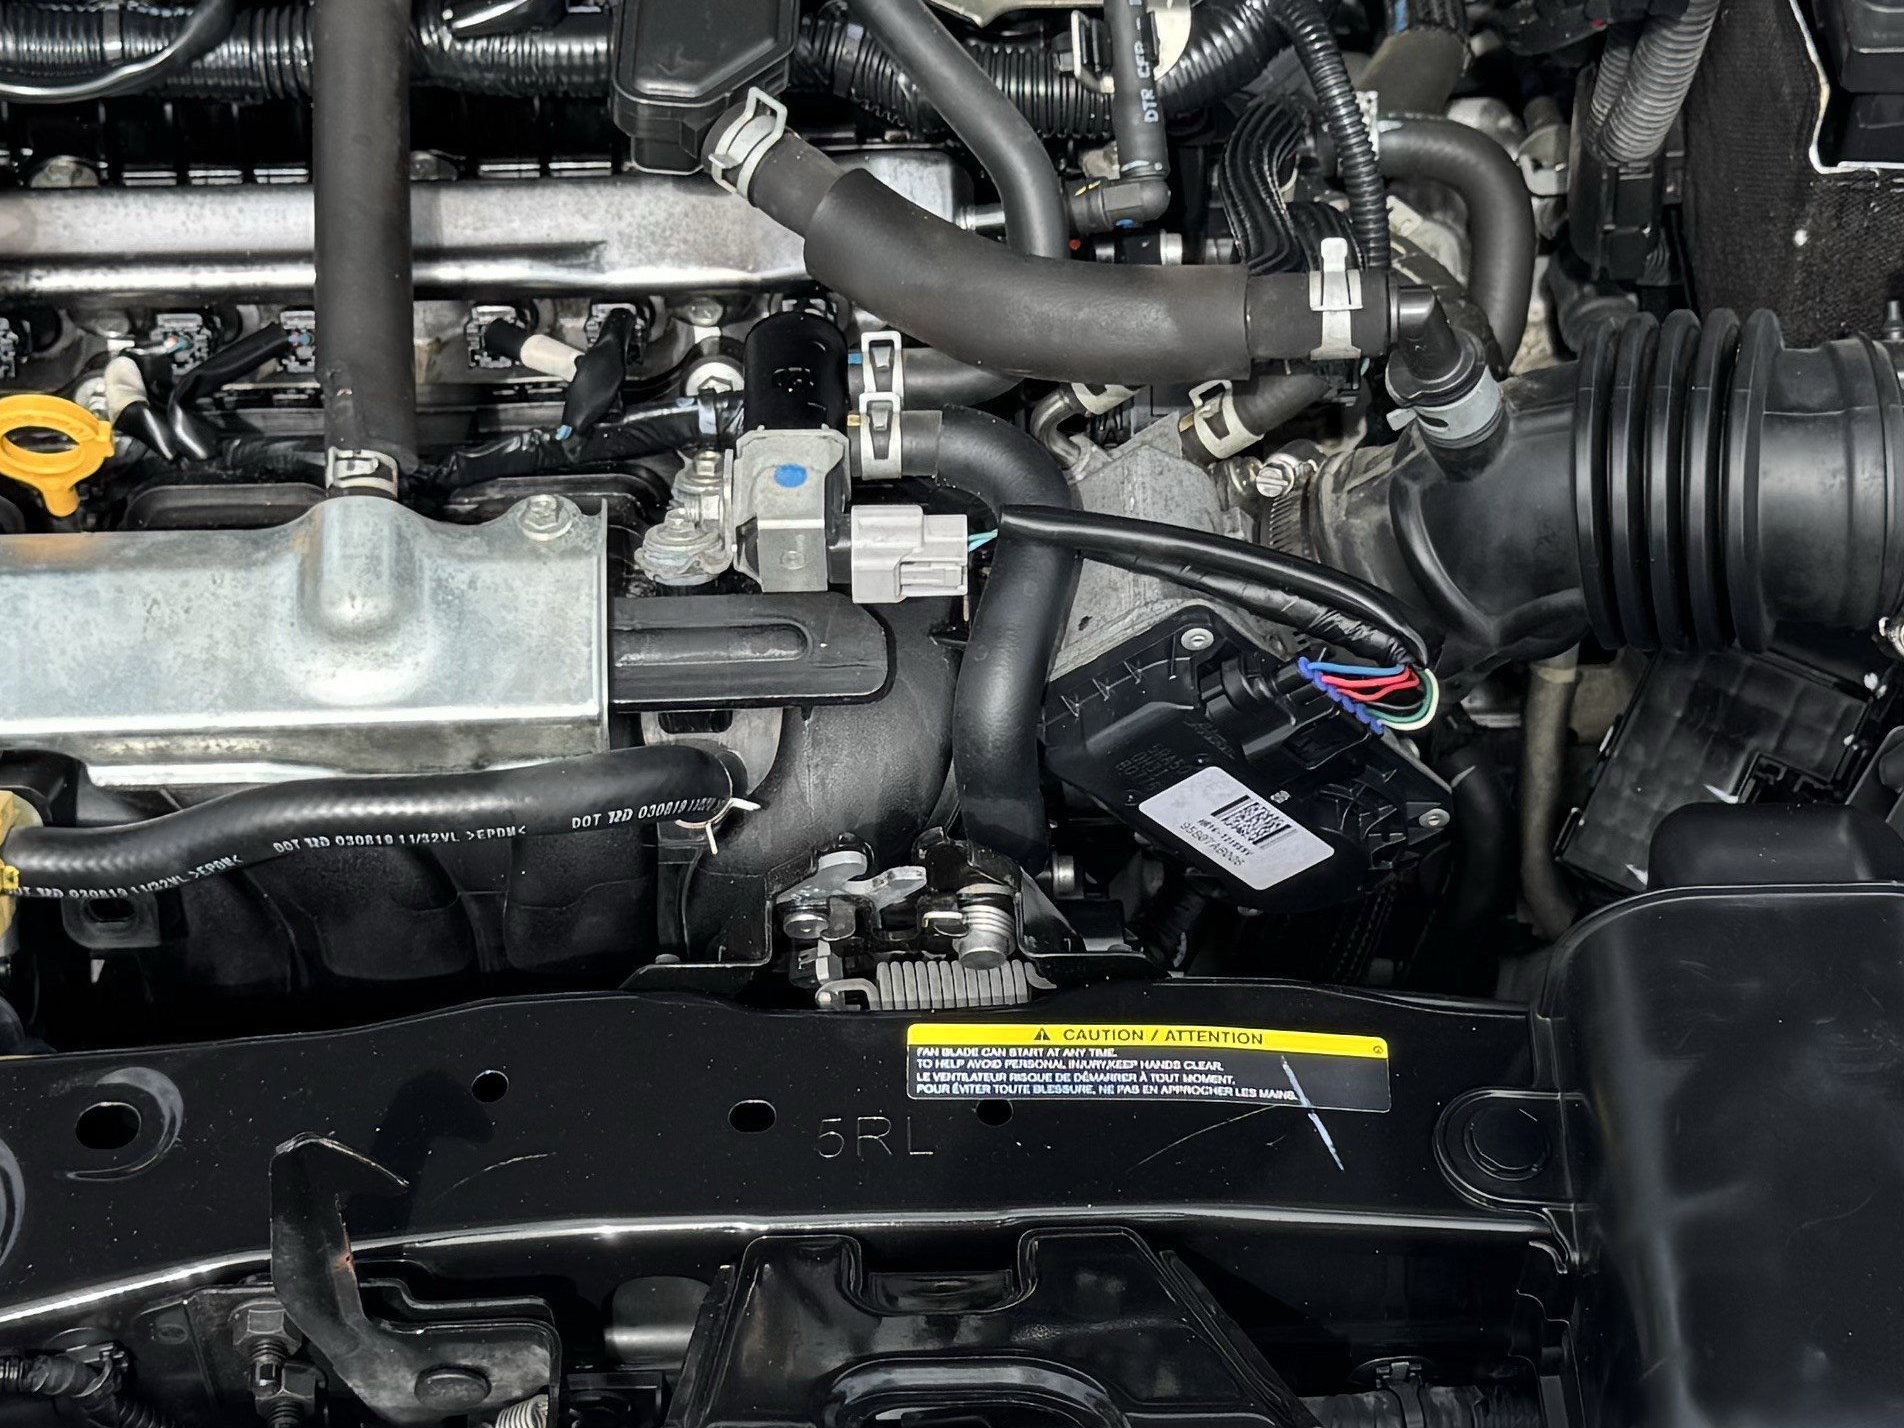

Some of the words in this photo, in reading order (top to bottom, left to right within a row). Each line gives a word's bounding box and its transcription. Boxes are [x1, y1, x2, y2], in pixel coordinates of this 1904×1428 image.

[1140, 88, 1159, 123] DTR
[571, 813, 602, 830] DOT
[638, 799, 687, 819] 030819
[273, 839, 302, 853] DOT
[1063, 1029, 1144, 1041] CAUTION
[1165, 1030, 1263, 1045] ATTENTION
[917, 1047, 939, 1057] FAN
[942, 1047, 978, 1057] BLADE
[981, 1047, 1007, 1057] CAN
[1009, 1047, 1044, 1057] START
[1047, 1047, 1060, 1057] AT
[1062, 1047, 1086, 1057] ANY
[1088, 1047, 1117, 1057] TIME.
[917, 1059, 933, 1069] TO
[935, 1059, 964, 1069] HELP
[967, 1059, 1002, 1069] AVOID
[1005, 1059, 1065, 1069] PERSONAL
[1140, 1060, 1181, 1070] HANDS
[1183, 1061, 1224, 1071] CLEAR.
[917, 1072, 930, 1082] LE
[933, 1072, 1007, 1082] VENTILATEUR
[1009, 1072, 1053, 1082] RISQUE
[1055, 1073, 1071, 1082] DE
[1139, 1071, 1148, 1082] À
[1150, 1074, 1180, 1083] TOUT
[1183, 1074, 1235, 1085] MOMENT.
[917, 1084, 950, 1094] POUR
[952, 1083, 990, 1094] ÉVITER
[993, 1084, 1030, 1094] TOUTE
[1099, 1085, 1115, 1094] NE
[1117, 1085, 1139, 1095] PAS
[1143, 1085, 1159, 1095] EN
[1161, 1085, 1233, 1097] APPROCHER
[1235, 1087, 1256, 1098] LES
[817, 1116, 934, 1159] 5RL
